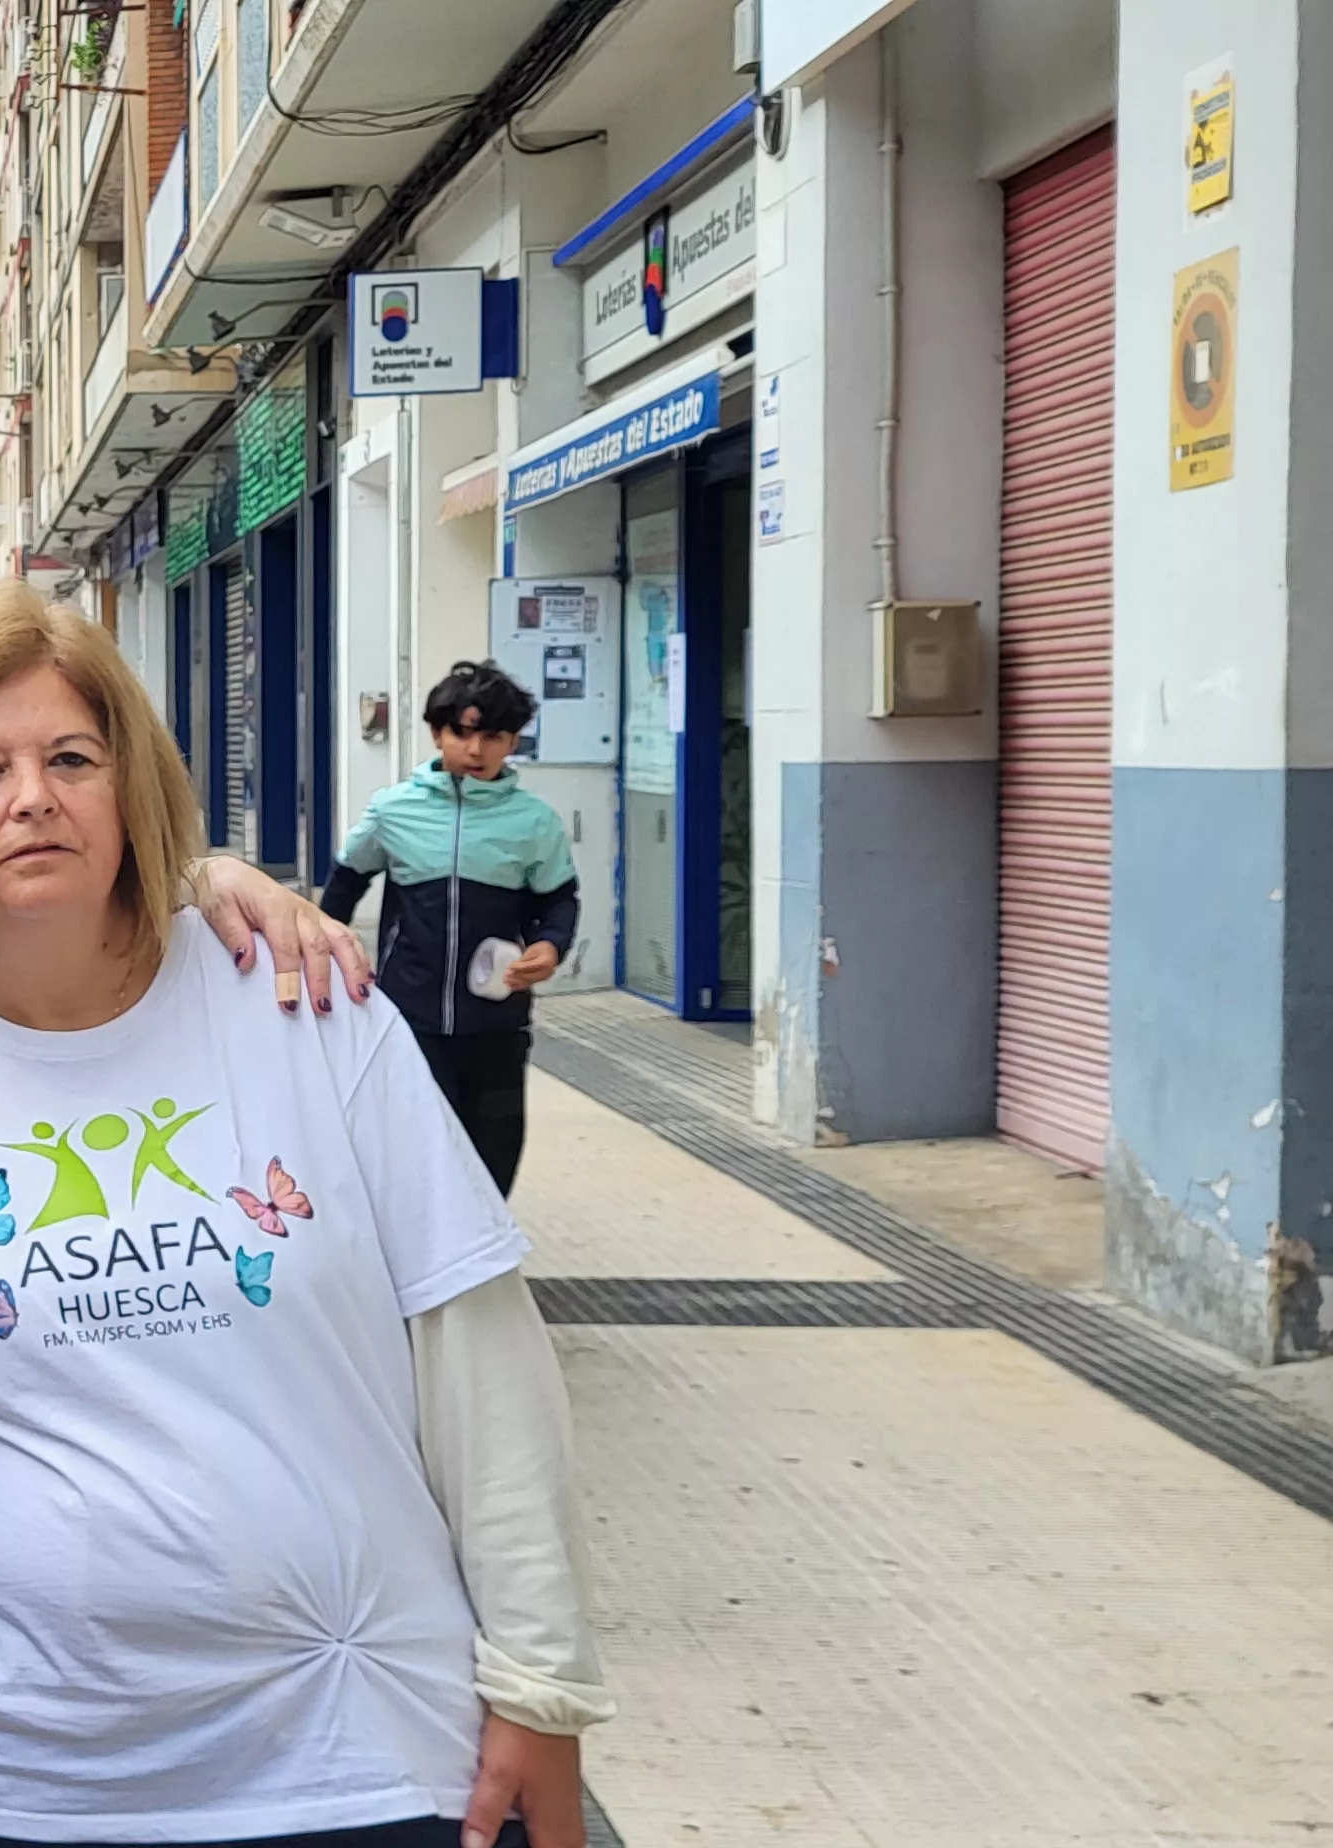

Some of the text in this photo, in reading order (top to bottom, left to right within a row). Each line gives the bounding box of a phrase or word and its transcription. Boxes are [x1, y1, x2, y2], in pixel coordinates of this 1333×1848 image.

[672, 209, 730, 282] Apuestas
[734, 176, 756, 234] del
[565, 428, 623, 481] Apuestas
[626, 412, 649, 453] del
[649, 388, 704, 444] Estado
[20, 1216, 231, 1288] ASAFA
[43, 1313, 232, 1348] FM, EM/SFC, SQM y EHS
[58, 1281, 205, 1324] HUESCA
